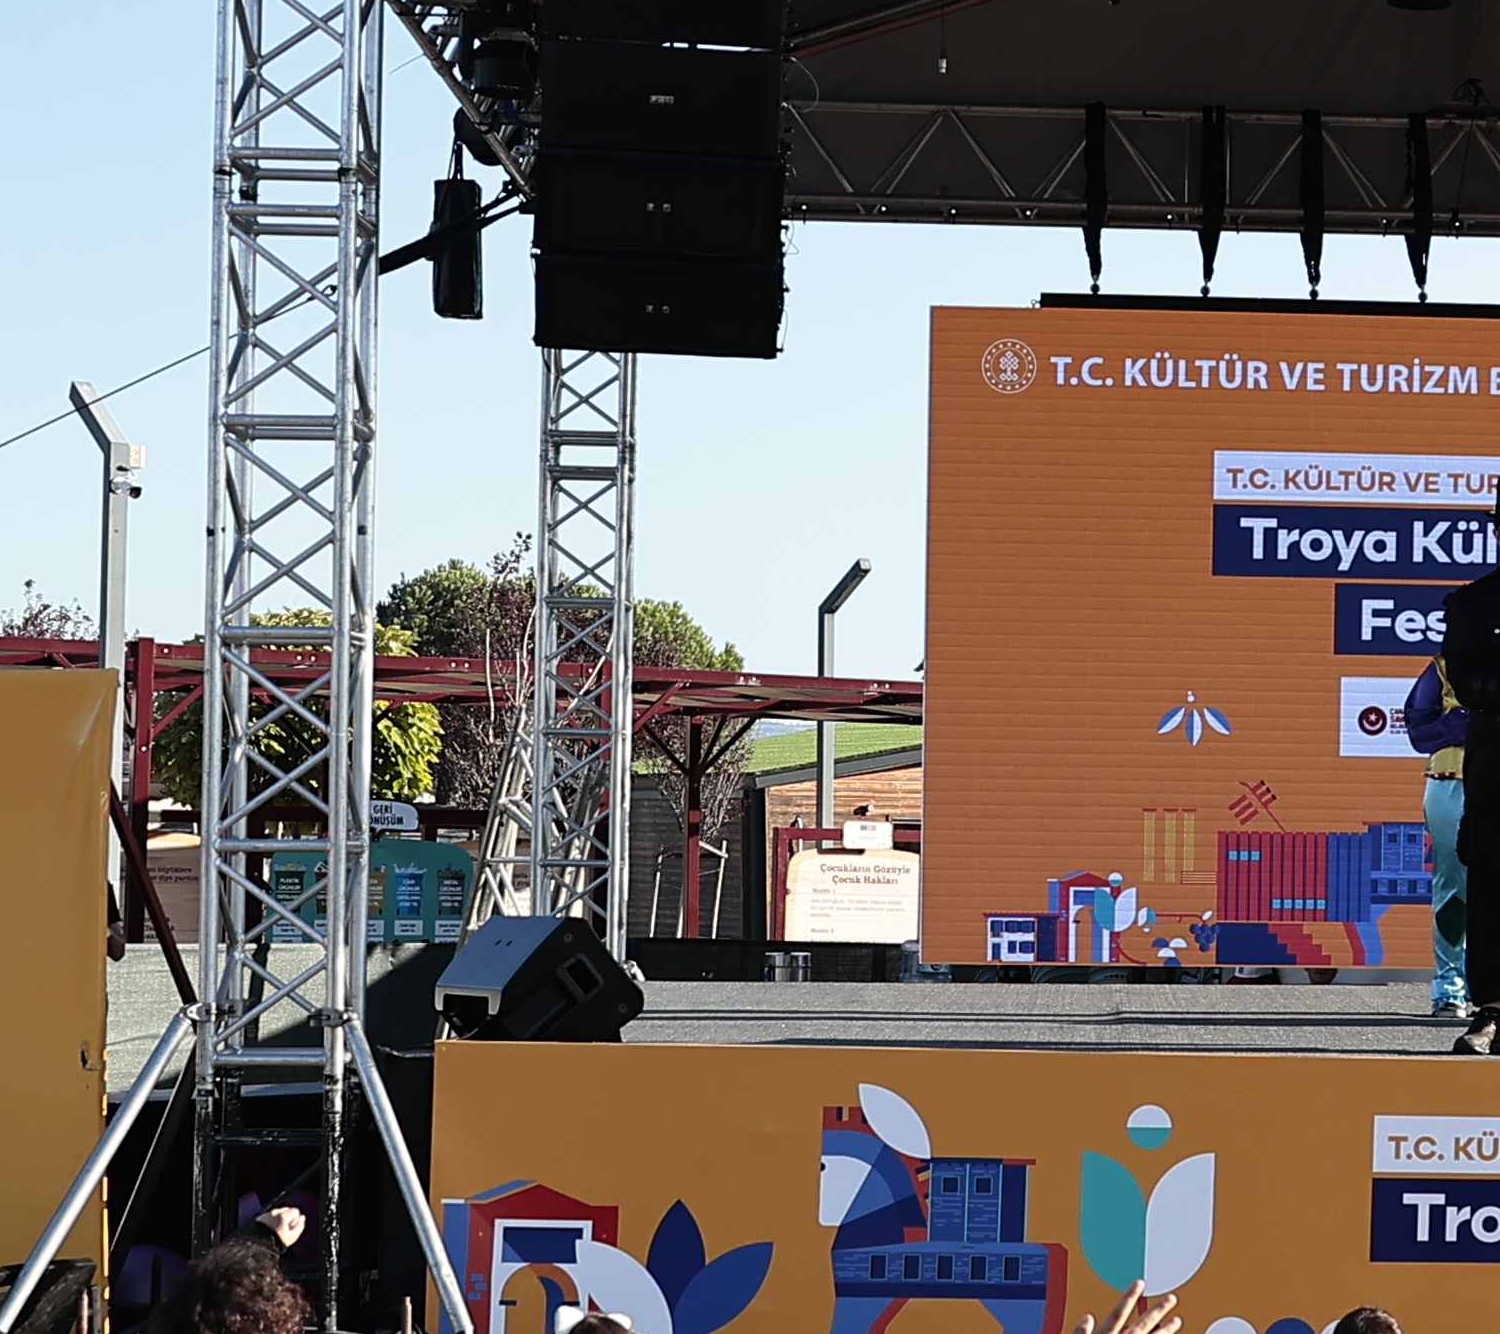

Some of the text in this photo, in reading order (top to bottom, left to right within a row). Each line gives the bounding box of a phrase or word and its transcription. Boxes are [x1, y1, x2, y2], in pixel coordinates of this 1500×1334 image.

[1049, 355, 1115, 387] T.C.
[1124, 351, 1269, 390] KÜLTÜR
[1278, 361, 1326, 391] VE
[1336, 357, 1478, 395] TURİZM
[1226, 467, 1278, 493] T.C.
[1283, 464, 1397, 495] KÜLTÜR
[1403, 472, 1440, 495] VE
[1239, 516, 1397, 571] Troya
[373, 803, 393, 814] GERİ
[370, 814, 404, 826] NÜŞÜM
[820, 863, 911, 876] Çocukların Gözüyle
[832, 875, 898, 886] Çocuk Hakları
[1387, 1134, 1446, 1163] T.C.
